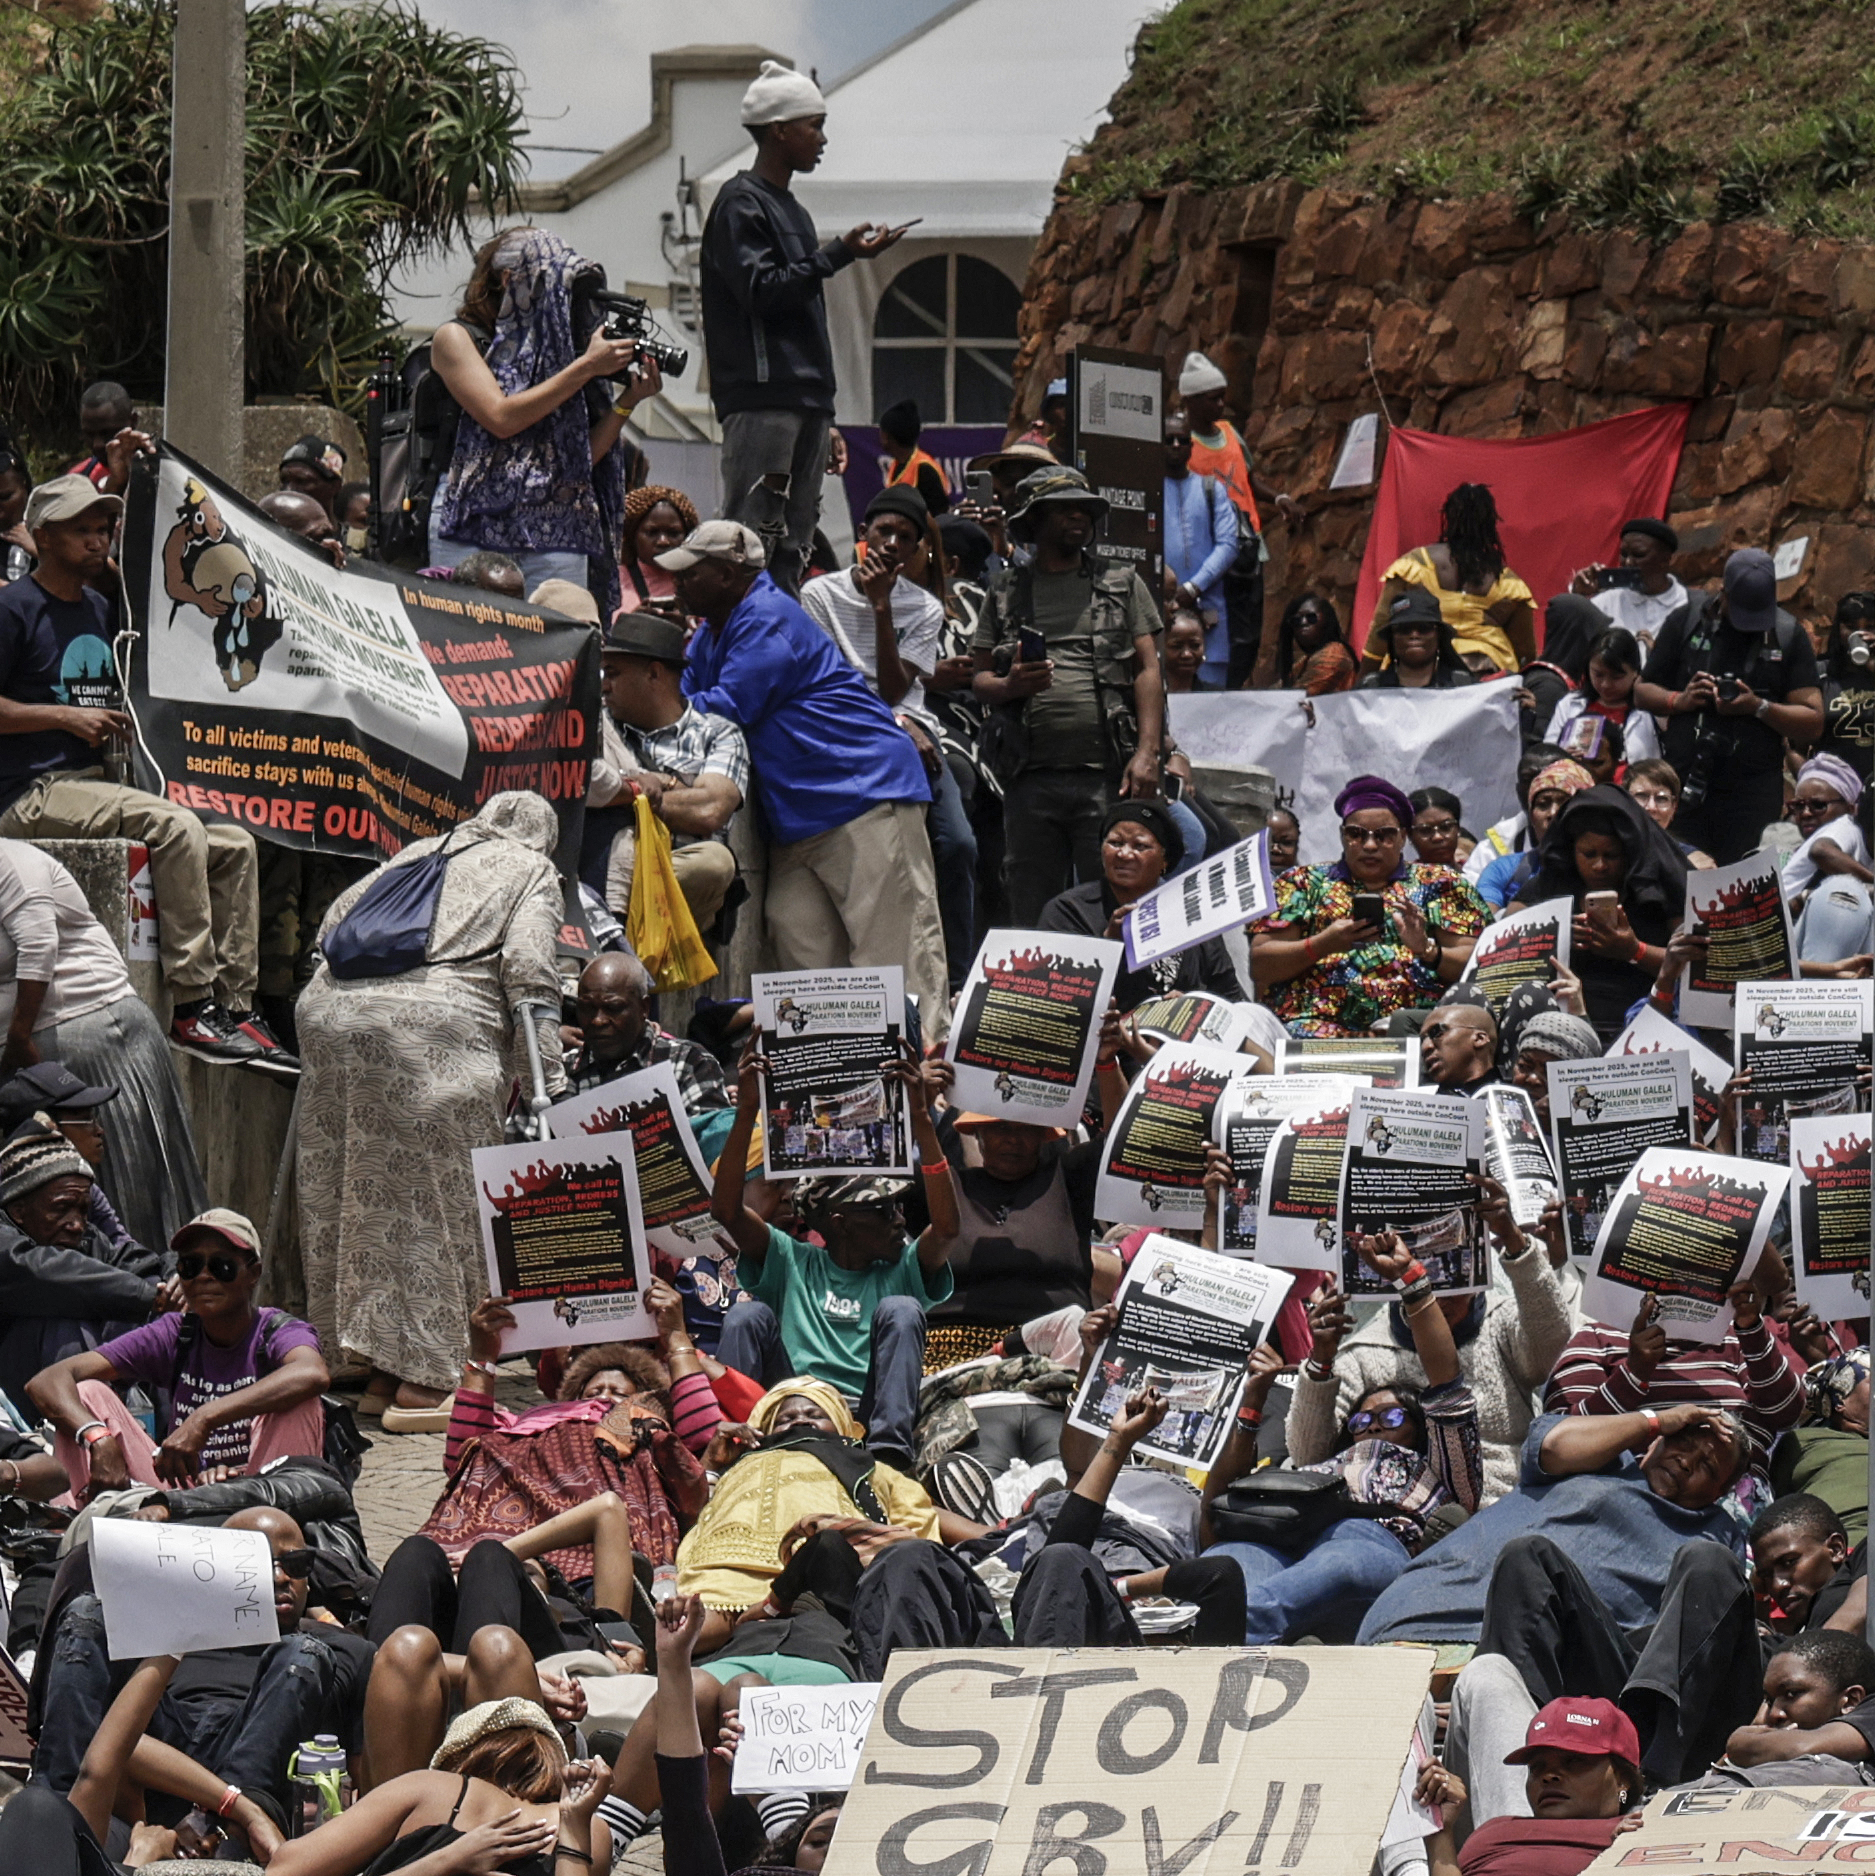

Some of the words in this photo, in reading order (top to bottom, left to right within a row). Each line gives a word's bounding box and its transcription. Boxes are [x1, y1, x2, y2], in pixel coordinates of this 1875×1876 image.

[333, 593, 413, 654] GALELA
[403, 587, 418, 606] In
[418, 590, 463, 616] human
[465, 601, 503, 625] rights
[505, 612, 545, 634] month
[446, 633, 514, 664] demand:
[183, 721, 202, 741] To
[206, 725, 225, 746] all
[229, 727, 288, 752] victims
[291, 736, 320, 755] and
[186, 755, 251, 778] sacrifice
[255, 761, 298, 787] stays
[303, 766, 334, 788] with
[338, 774, 354, 789] us
[167, 780, 316, 832] RESTORE
[763, 988, 796, 996] sleeping
[815, 984, 845, 992] outside
[773, 979, 811, 987] November
[824, 1290, 861, 1314] 1994
[749, 1692, 812, 1739] FOR
[821, 1699, 877, 1736] MY
[864, 1655, 1310, 1790] STOP
[768, 1738, 847, 1776] MOM
